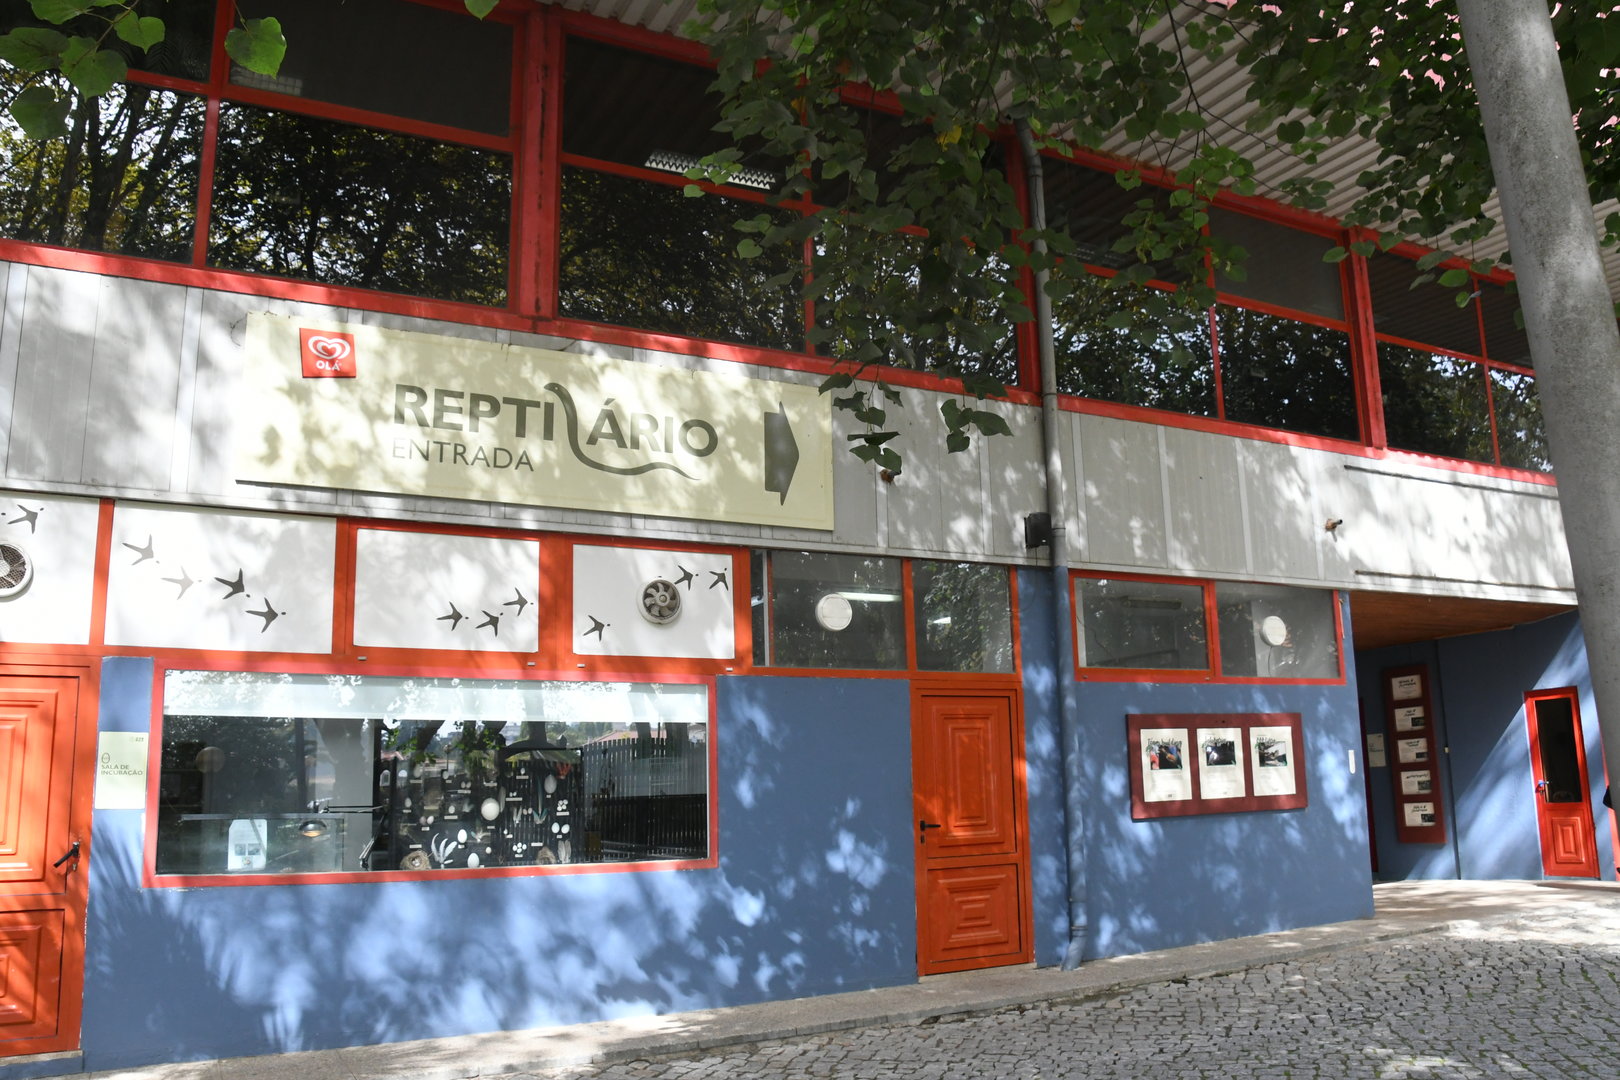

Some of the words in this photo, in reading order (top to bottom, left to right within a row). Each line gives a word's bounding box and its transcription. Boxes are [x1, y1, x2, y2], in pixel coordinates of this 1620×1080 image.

[316, 360, 341, 371] OLÁ
[394, 383, 719, 472] REPTILÁRIO
[392, 437, 535, 472] ENTRADA
